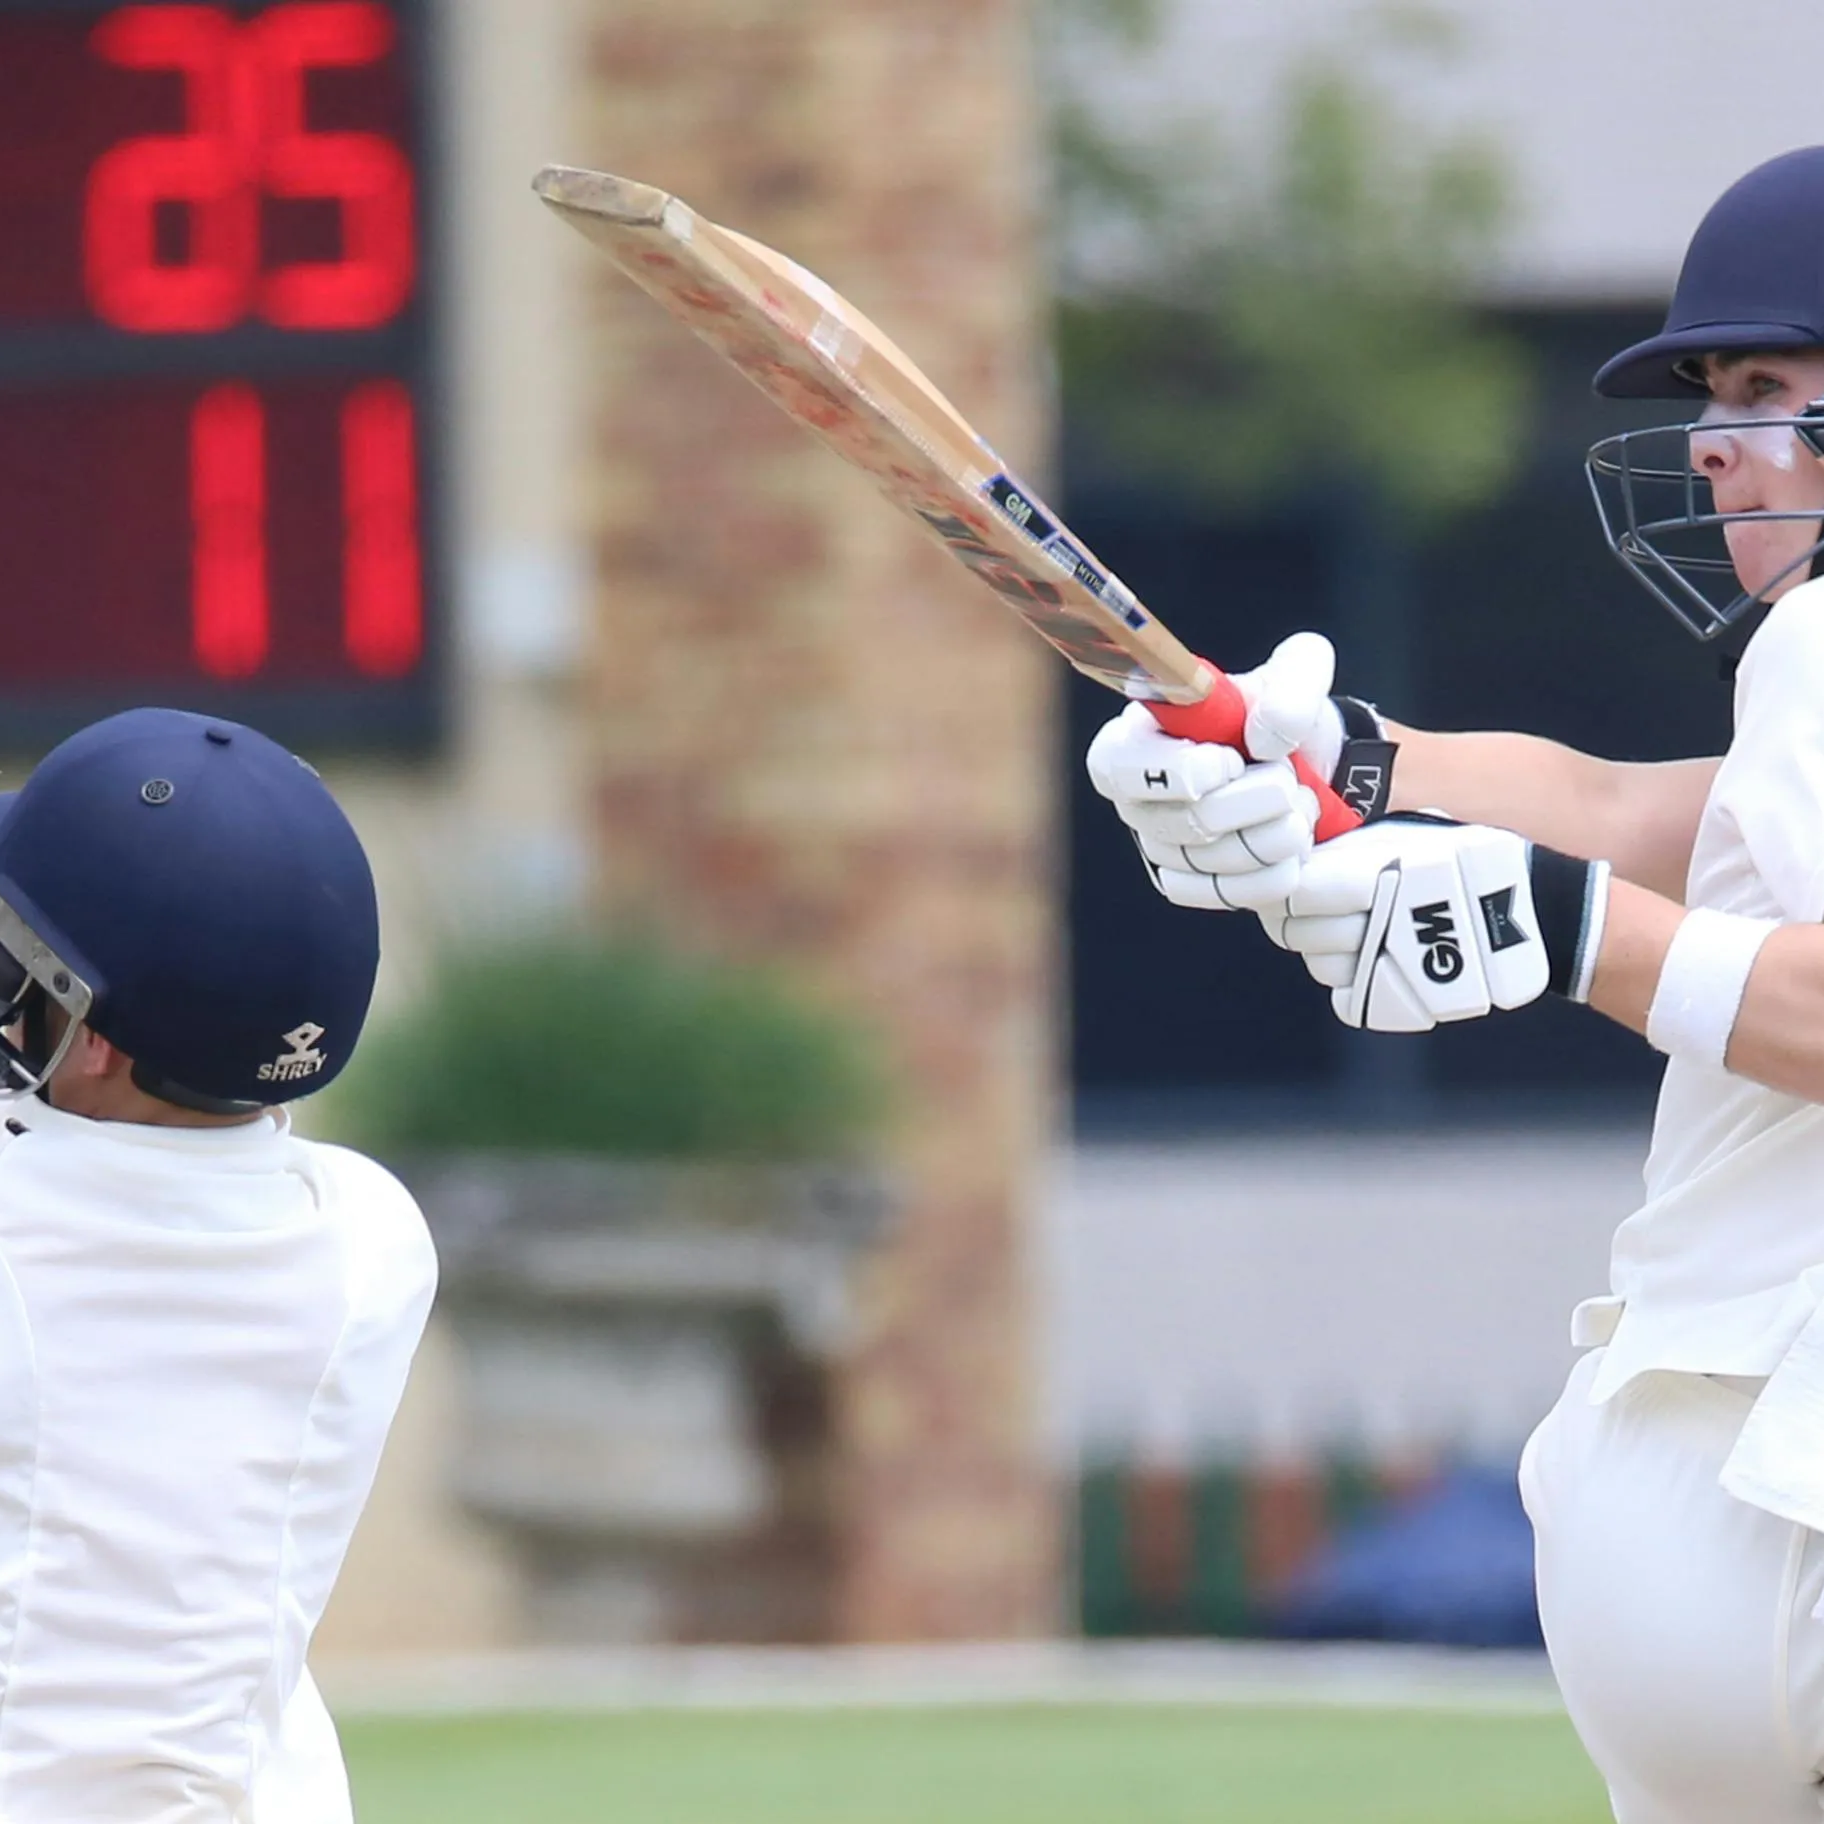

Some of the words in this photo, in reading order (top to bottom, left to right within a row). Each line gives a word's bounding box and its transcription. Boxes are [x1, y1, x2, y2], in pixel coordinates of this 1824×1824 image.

[189, 387, 422, 678] 11
[1004, 492, 1034, 525] GM
[1342, 765, 1382, 820] M
[1410, 899, 1465, 985] GM
[256, 1053, 328, 1081] SHREY
